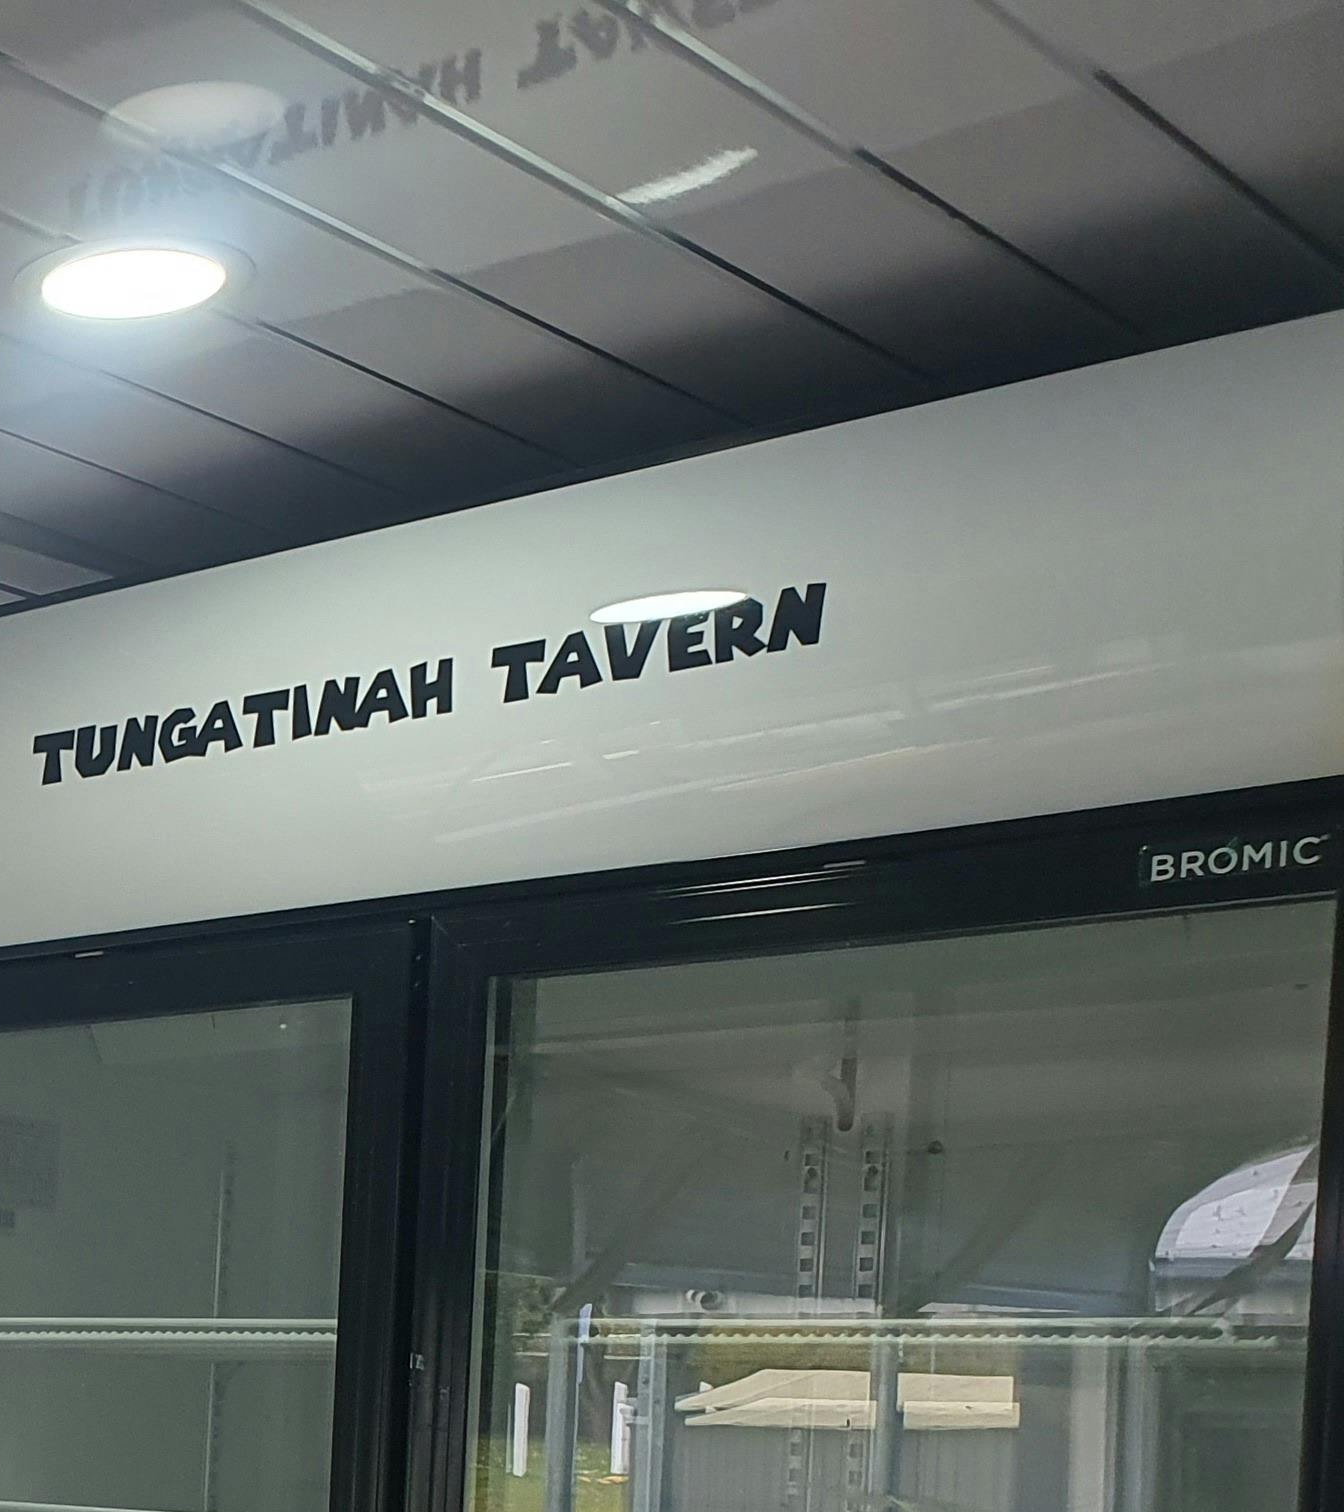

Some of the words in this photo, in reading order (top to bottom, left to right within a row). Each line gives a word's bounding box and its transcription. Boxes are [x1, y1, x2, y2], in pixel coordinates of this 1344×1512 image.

[32, 658, 454, 785] TUNGATINAH
[491, 582, 827, 703] TAVERN
[1150, 836, 1322, 882] BROMIC
